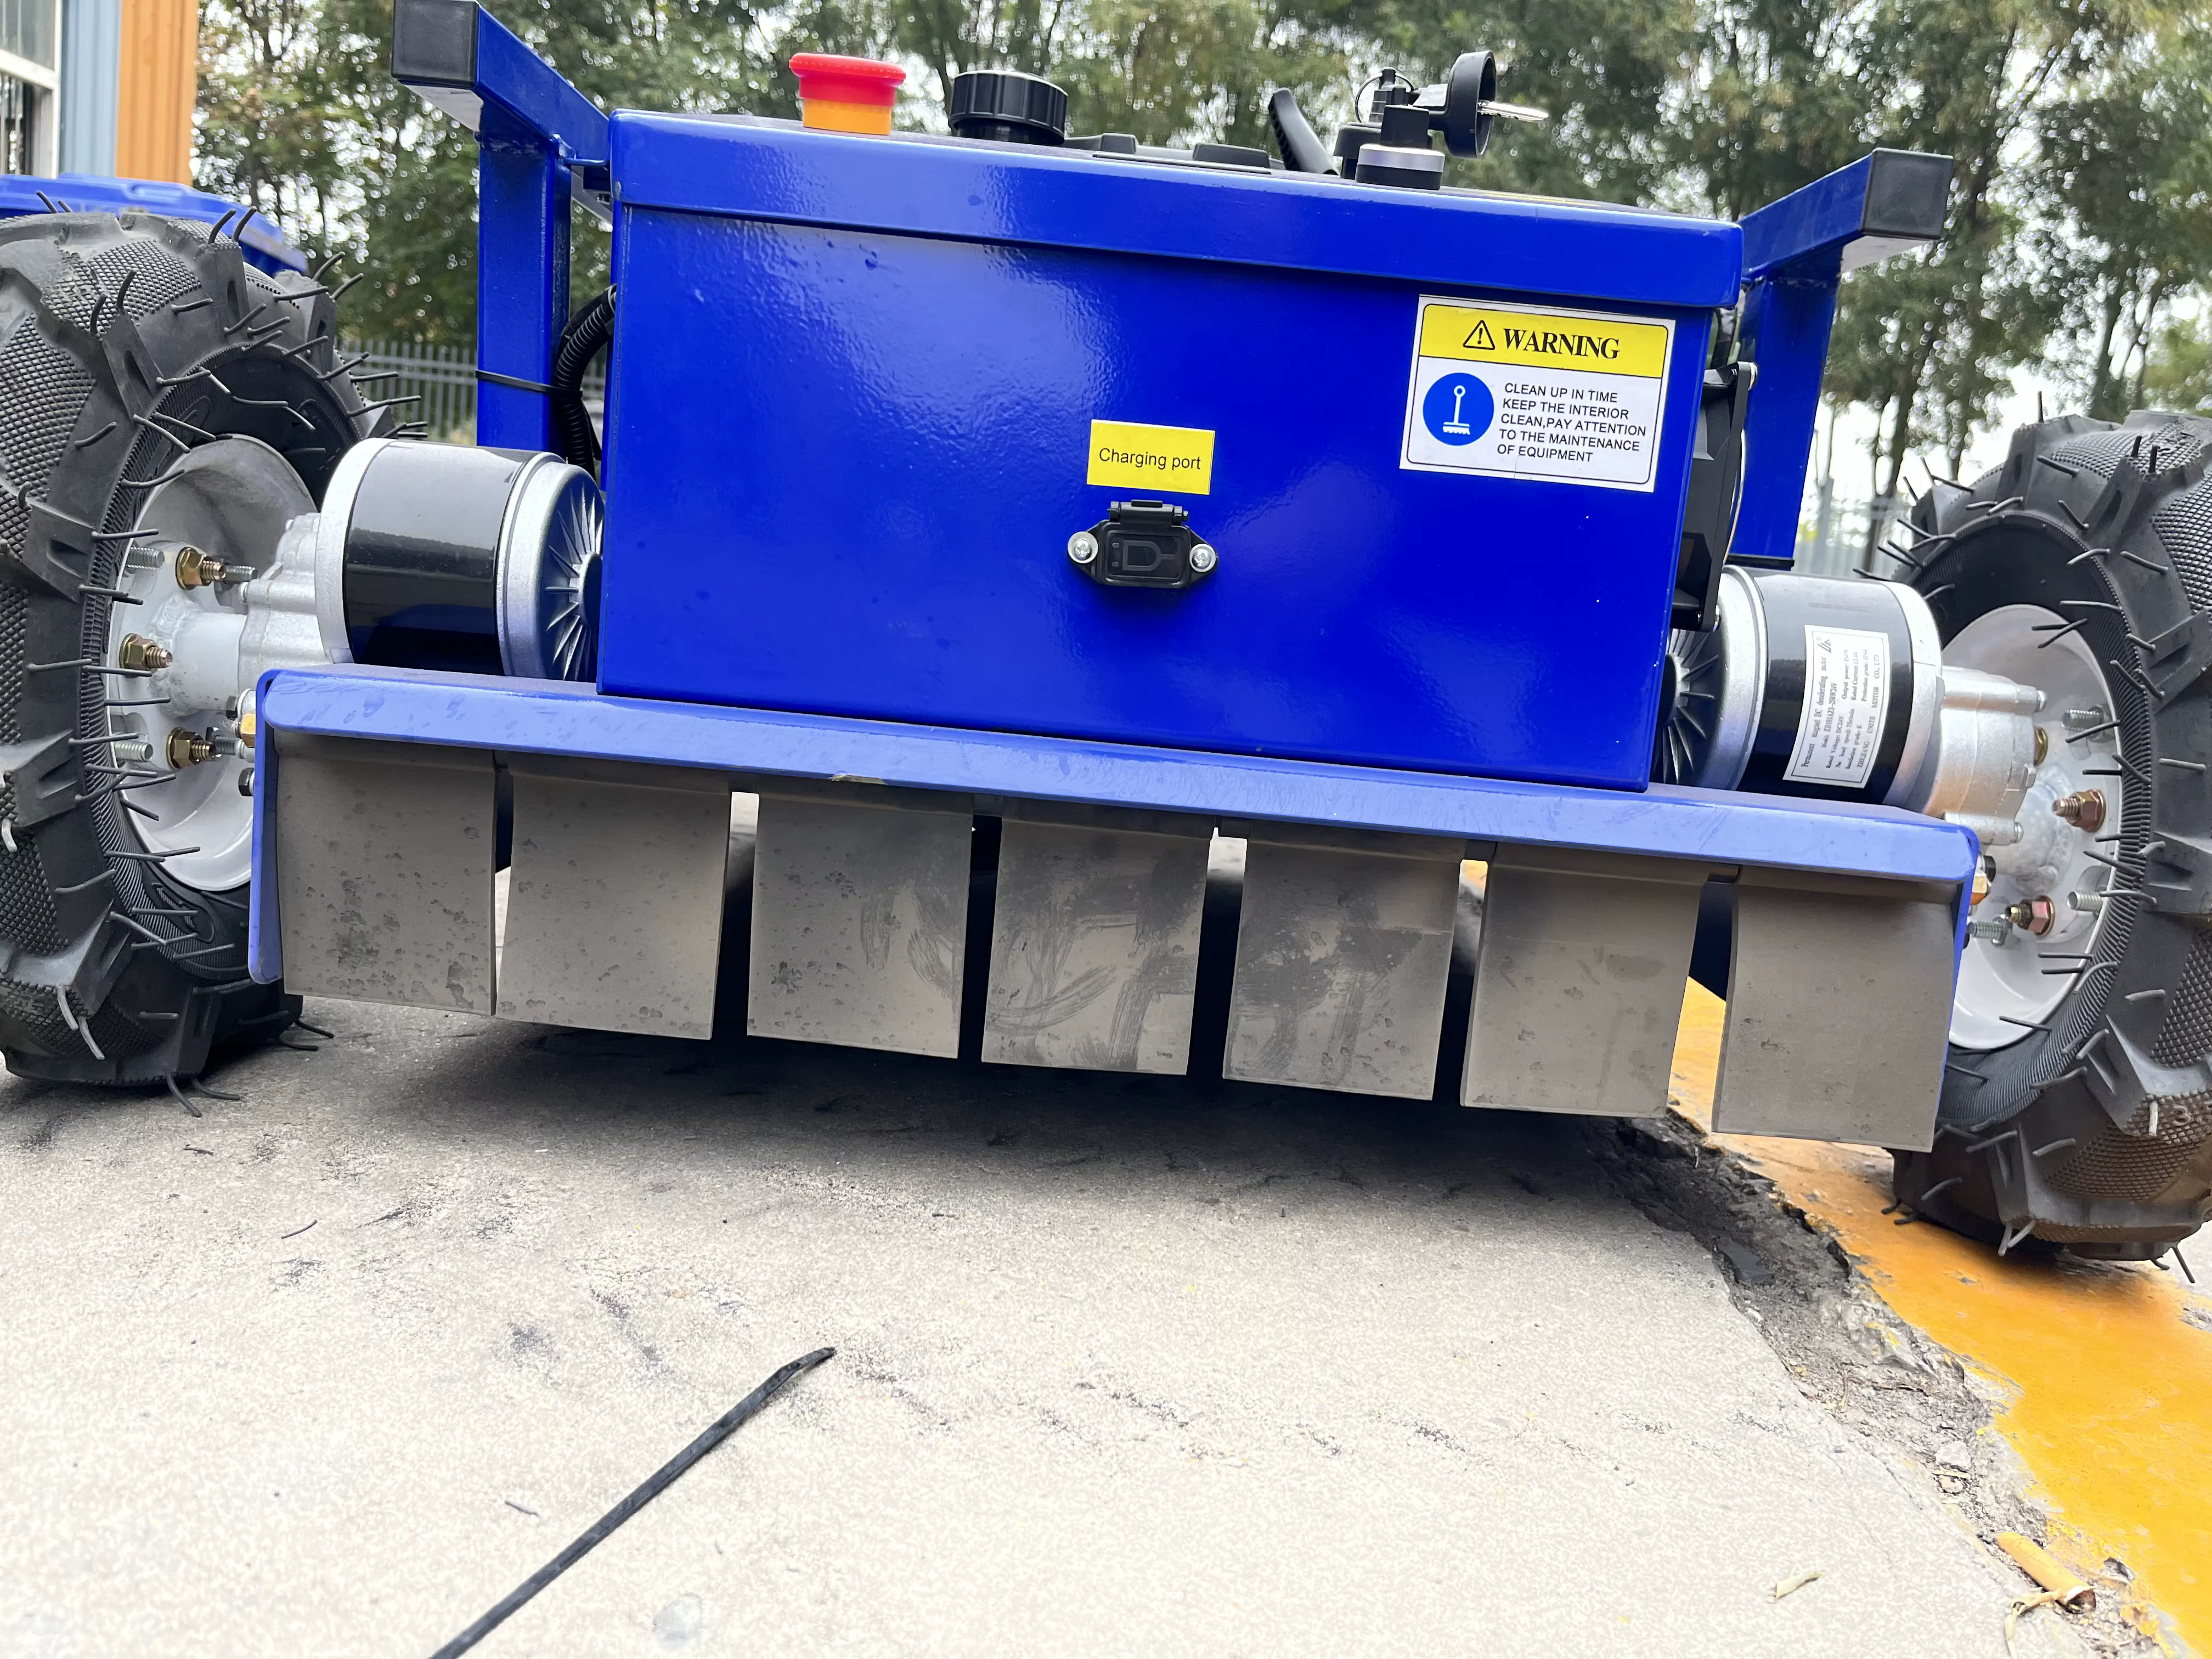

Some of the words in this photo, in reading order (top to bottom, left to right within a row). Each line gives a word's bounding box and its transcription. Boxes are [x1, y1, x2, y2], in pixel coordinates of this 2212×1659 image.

[1504, 328, 1620, 359] WARNING
[1505, 383, 1547, 396] CLEAN
[1550, 387, 1568, 398] UP
[1572, 390, 1584, 399] IN
[1588, 390, 1618, 403] TIME
[1503, 399, 1536, 411] KEEP
[1540, 402, 1565, 414] THE
[1569, 404, 1629, 419] INTERIOR
[1501, 414, 1573, 431] CLEAN,PAY
[1575, 420, 1646, 436] ATTENTION
[1499, 429, 1516, 440] TO
[1520, 431, 1545, 443] THE
[1549, 433, 1640, 451] MAINTENANCE
[1099, 448, 1166, 470] Charging
[1172, 456, 1201, 470] port
[1497, 444, 1515, 455] OF
[1518, 445, 1593, 462] EQUIPMENT
[1814, 709, 1822, 717] DC
[1867, 716, 1875, 733] UNITE
